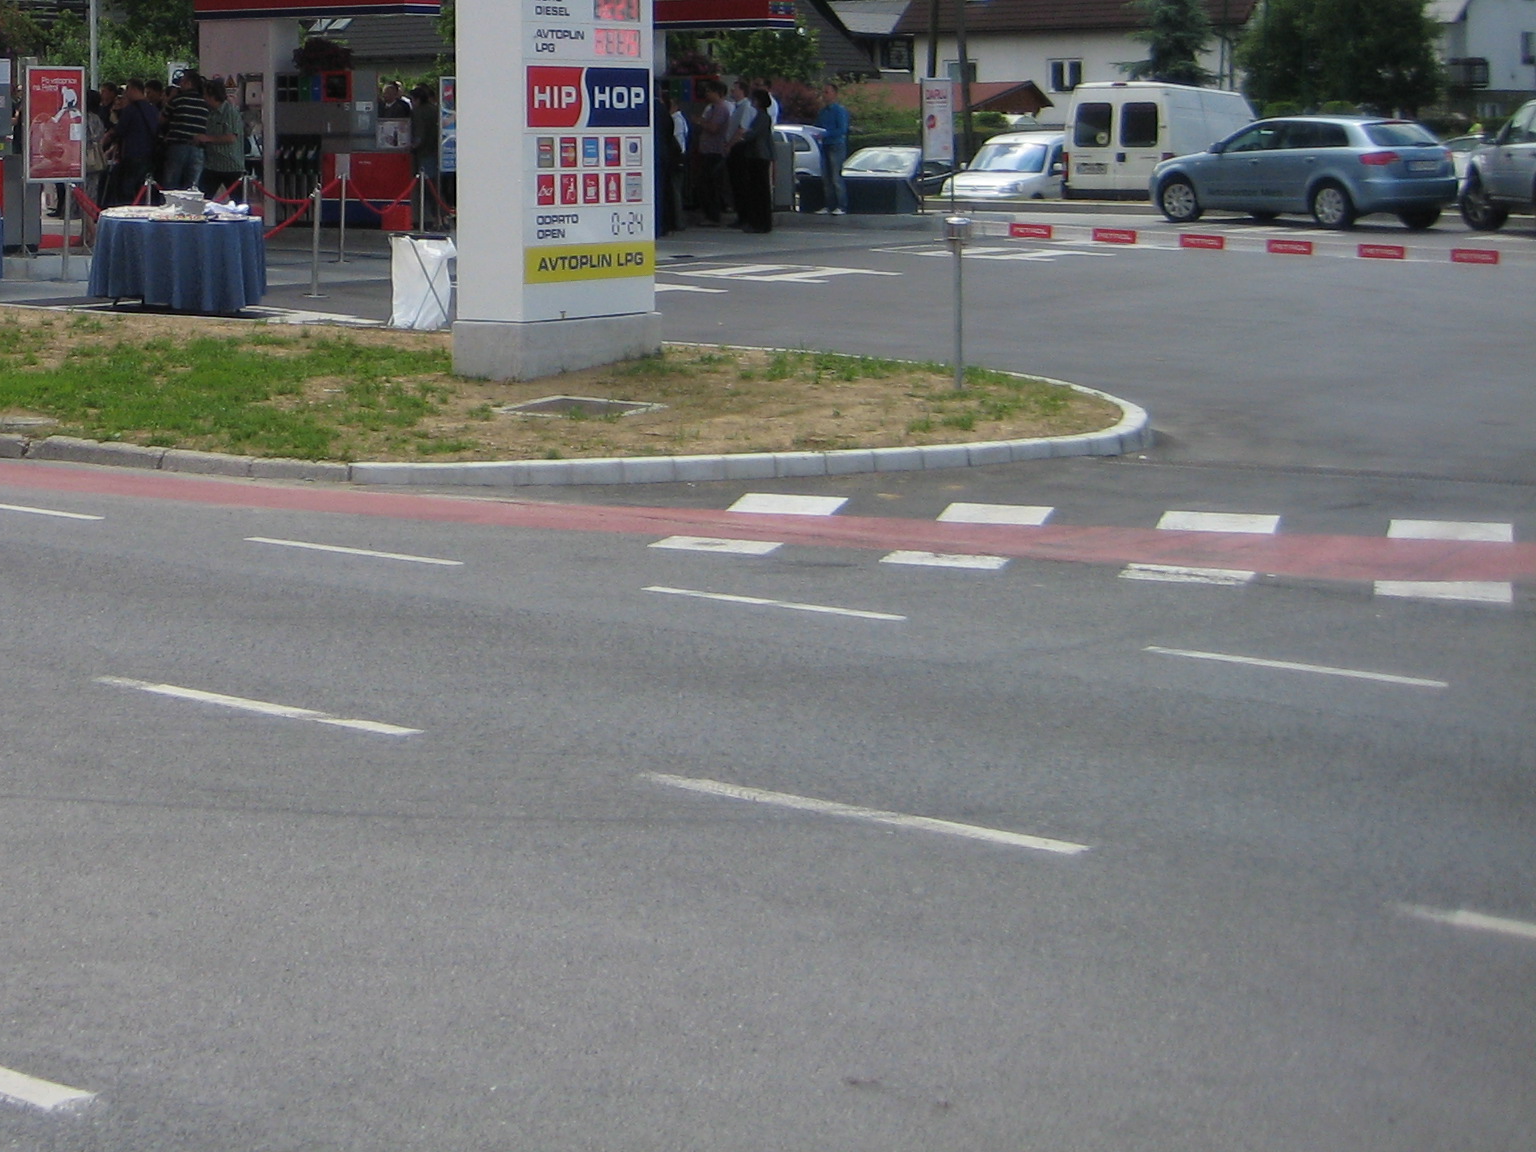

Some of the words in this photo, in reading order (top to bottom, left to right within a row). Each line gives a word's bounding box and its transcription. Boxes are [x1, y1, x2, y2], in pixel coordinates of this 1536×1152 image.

[535, 5, 570, 17] DIESEL
[536, 29, 585, 41] AVTOPLIN
[535, 43, 555, 53] LPG
[533, 85, 577, 109] HIP
[594, 86, 645, 110] HOP
[537, 214, 579, 226] ODPRTO
[611, 212, 644, 236] 0-24
[537, 229, 565, 239] OPEN
[538, 253, 612, 272] AVTOPLIN
[617, 251, 644, 267] LPG
